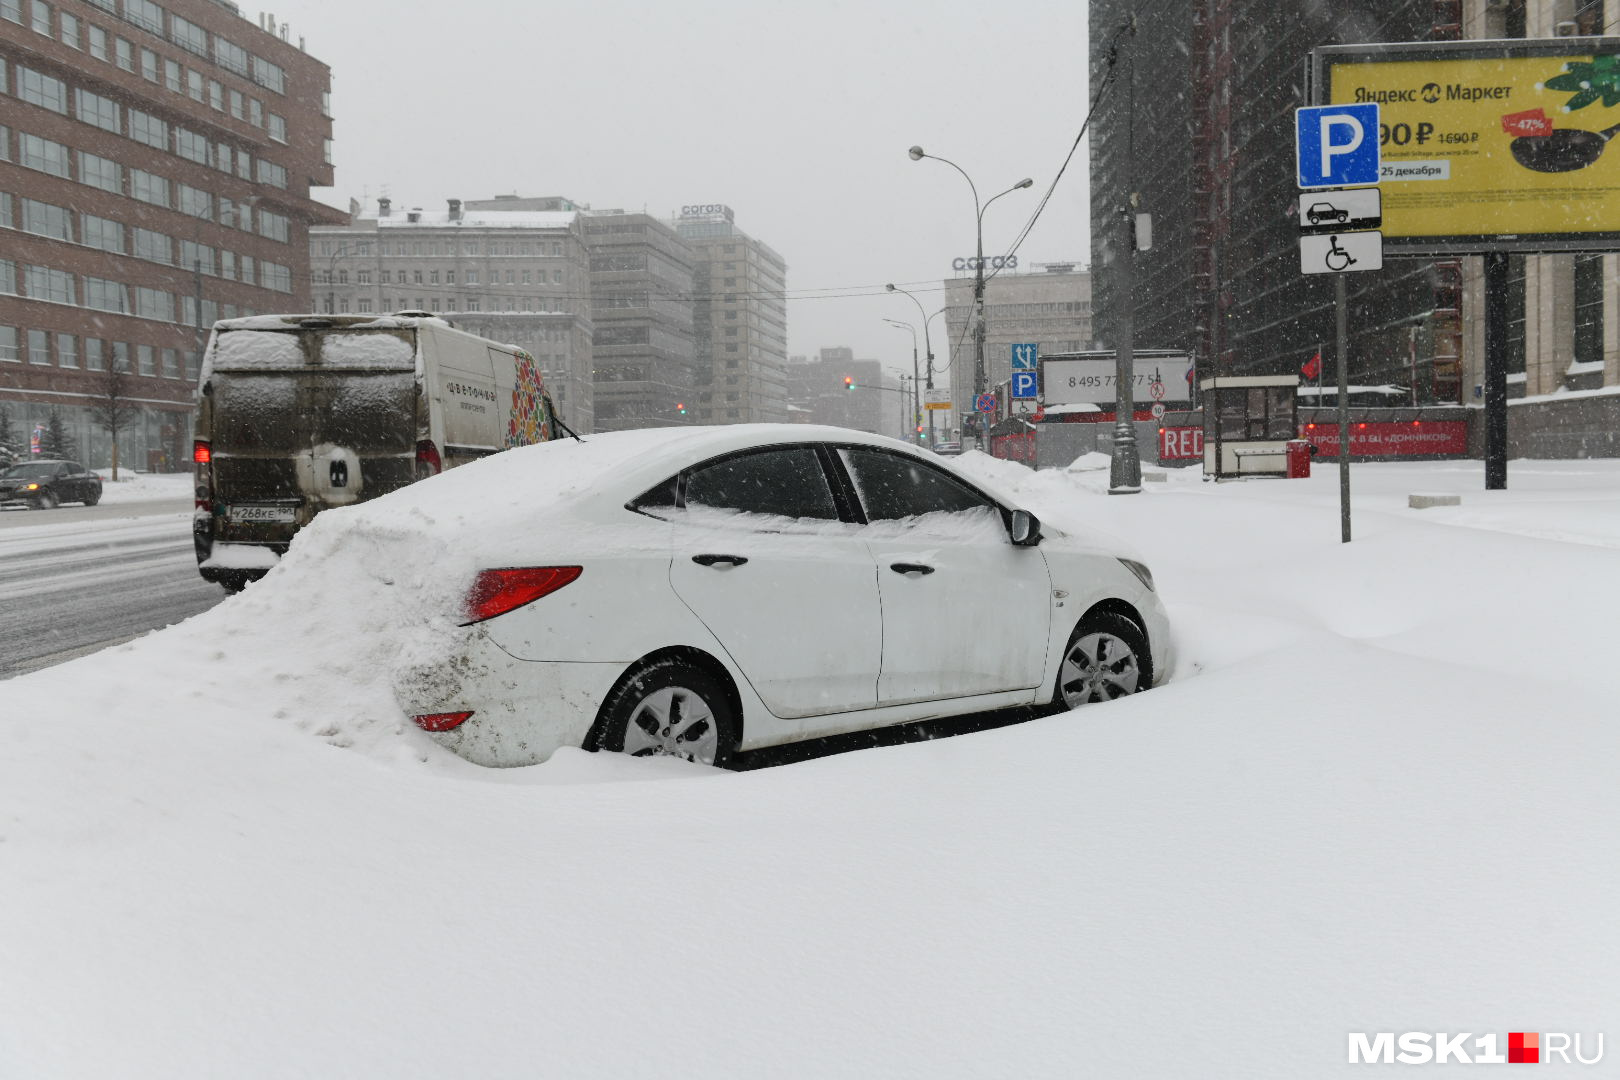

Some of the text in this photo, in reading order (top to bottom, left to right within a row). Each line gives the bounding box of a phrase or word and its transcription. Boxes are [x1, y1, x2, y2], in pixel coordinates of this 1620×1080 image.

[1354, 84, 1512, 104] Яндекс Маркет
[1320, 114, 1364, 177] P
[1381, 165, 1442, 176] 25 декабря
[1018, 375, 1033, 395] P
[1068, 376, 1076, 388] 8
[1079, 376, 1101, 387] 495
[1155, 407, 1161, 415] 10
[1314, 435, 1357, 444] ПРОДЖ
